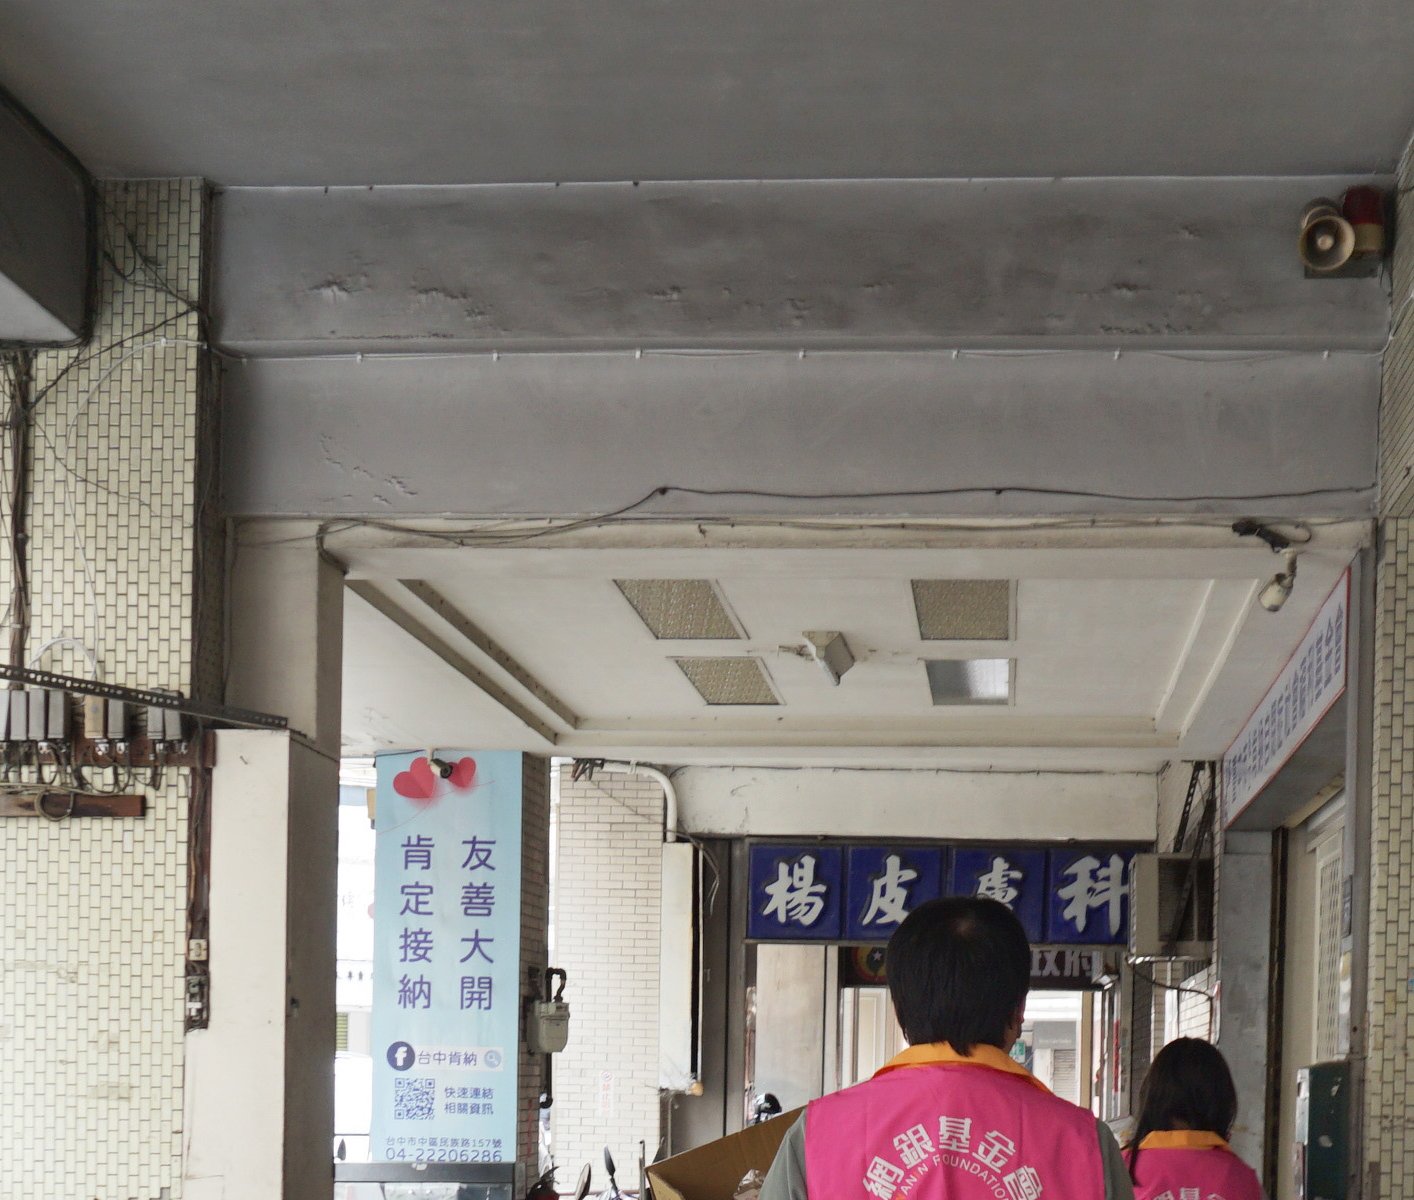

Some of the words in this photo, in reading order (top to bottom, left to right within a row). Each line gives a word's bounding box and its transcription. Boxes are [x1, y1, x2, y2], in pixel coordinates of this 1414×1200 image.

[397, 834, 435, 1010] 肯定接納
[460, 834, 497, 1012] 友善大開
[418, 1050, 478, 1067] 台中肯納
[444, 1102, 494, 1115] 相關資訊
[386, 1147, 503, 1163] 04-22206286
